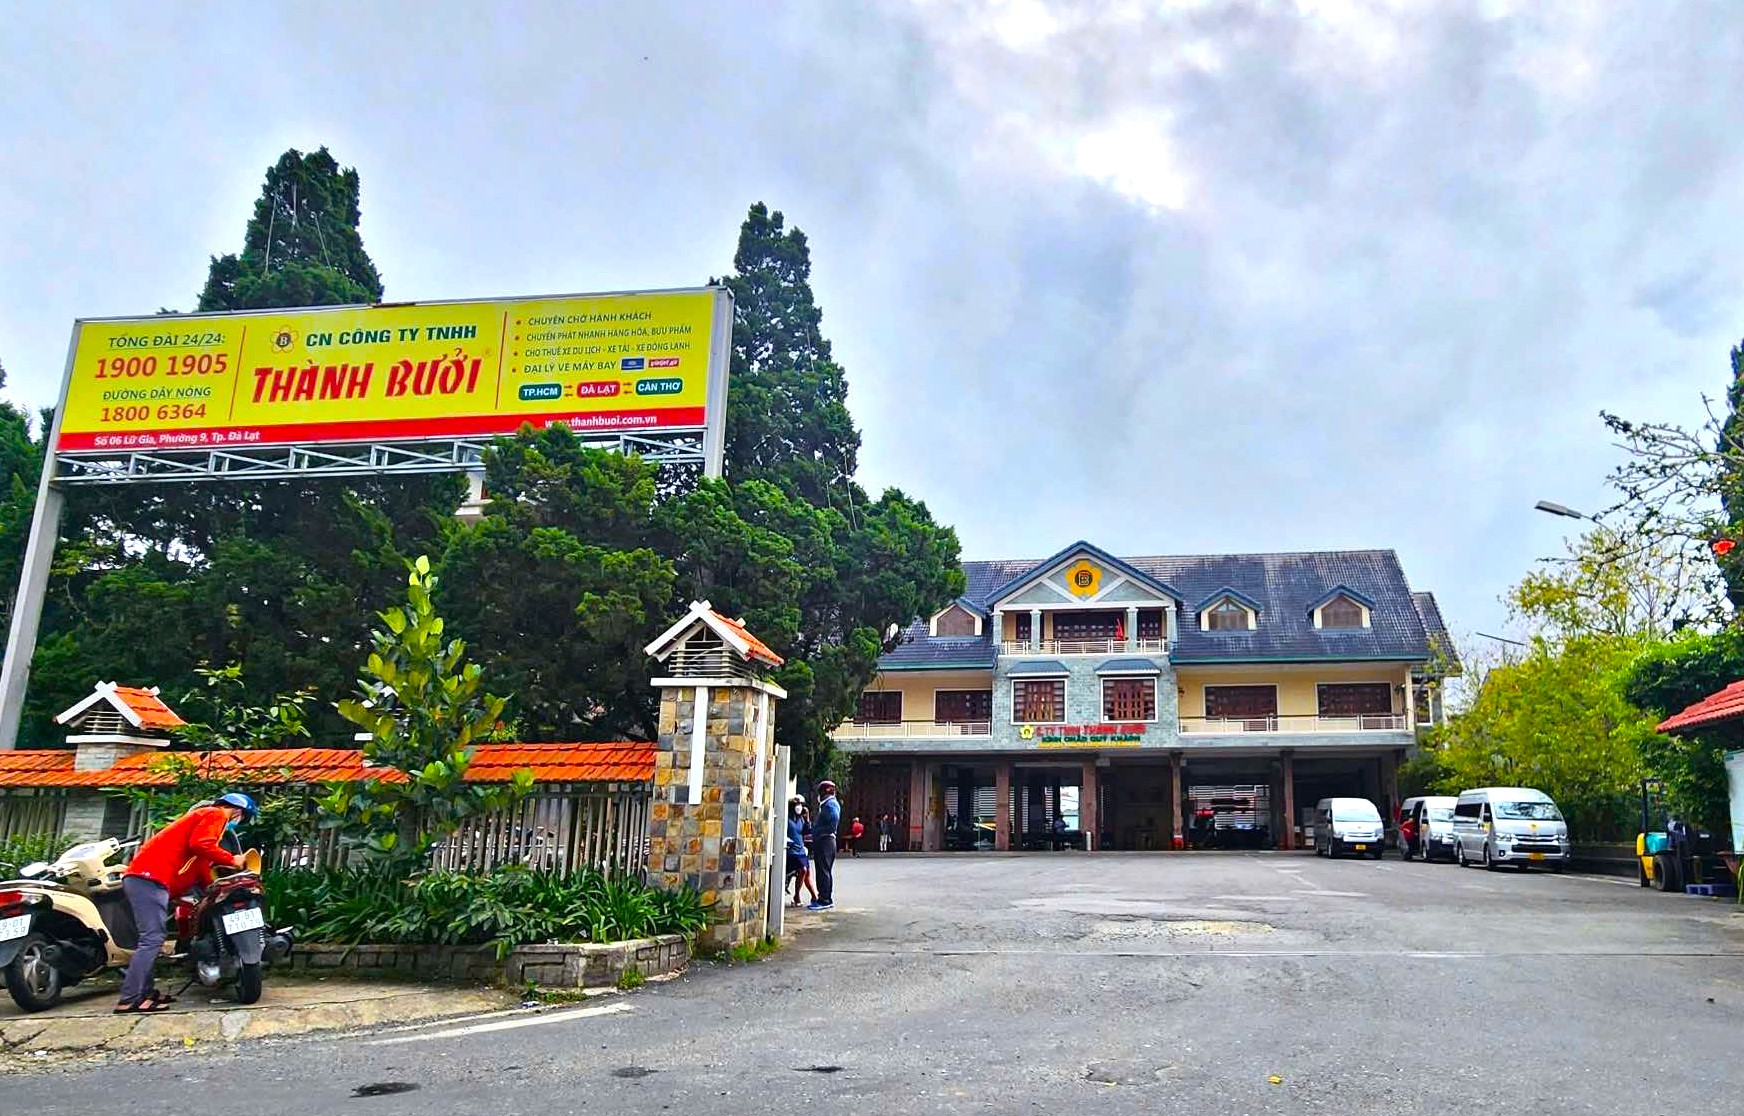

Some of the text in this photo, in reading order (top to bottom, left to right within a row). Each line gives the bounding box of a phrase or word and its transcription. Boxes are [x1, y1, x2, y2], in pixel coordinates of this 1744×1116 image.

[109, 332, 226, 348] TỔNG ĐÀI 24/24:
[305, 325, 477, 347] CN CÔNG TY TNHH
[95, 354, 228, 378] 1900 1905
[524, 363, 542, 374] ĐẠI
[597, 360, 617, 370] BAY
[252, 347, 482, 403] THÀNH BƯỞI
[103, 386, 147, 400] ĐƯỜNG
[522, 386, 558, 398] TP.HCM
[580, 383, 616, 396] ĐÀ LẠT
[637, 380, 681, 393] CẦN THƠ
[101, 403, 206, 422] 1800 6364
[109, 435, 122, 445] 06
[159, 432, 197, 446] Phường
[199, 432, 208, 443] 9,
[211, 431, 226, 444] Tp.
[228, 430, 242, 441] Đà
[244, 430, 261, 442] Lạt
